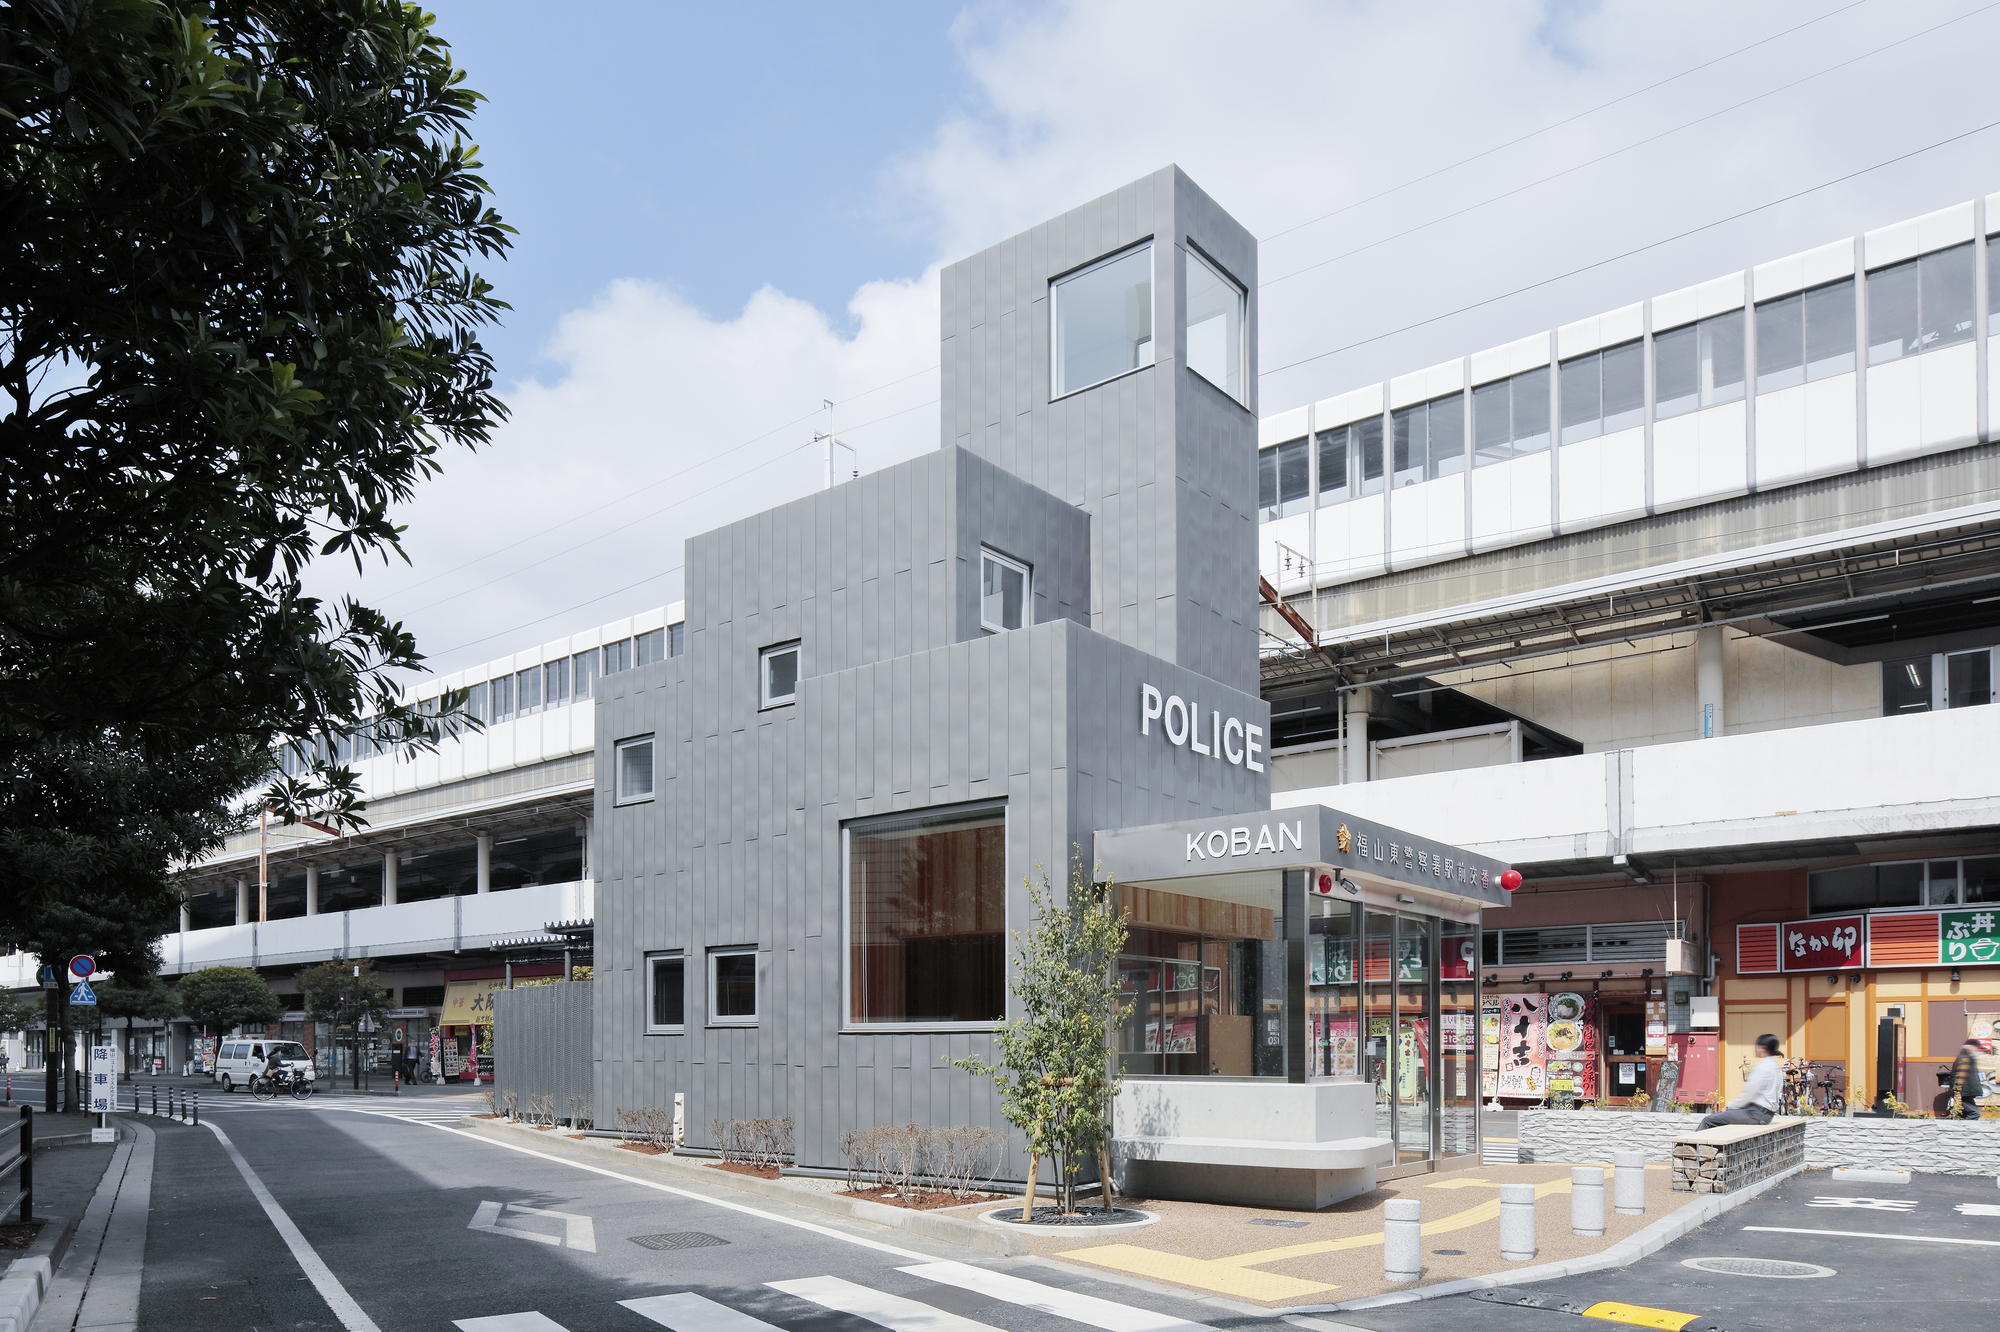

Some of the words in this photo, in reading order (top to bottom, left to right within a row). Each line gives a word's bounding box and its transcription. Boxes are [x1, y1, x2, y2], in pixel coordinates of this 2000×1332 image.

[1142, 682, 1264, 773] POLICE
[1186, 820, 1302, 861] KOBAN
[1356, 831, 1490, 889] 福山東警察署駅前交番
[1789, 926, 1857, 959] なか卯
[94, 1048, 108, 1111] 降車場
